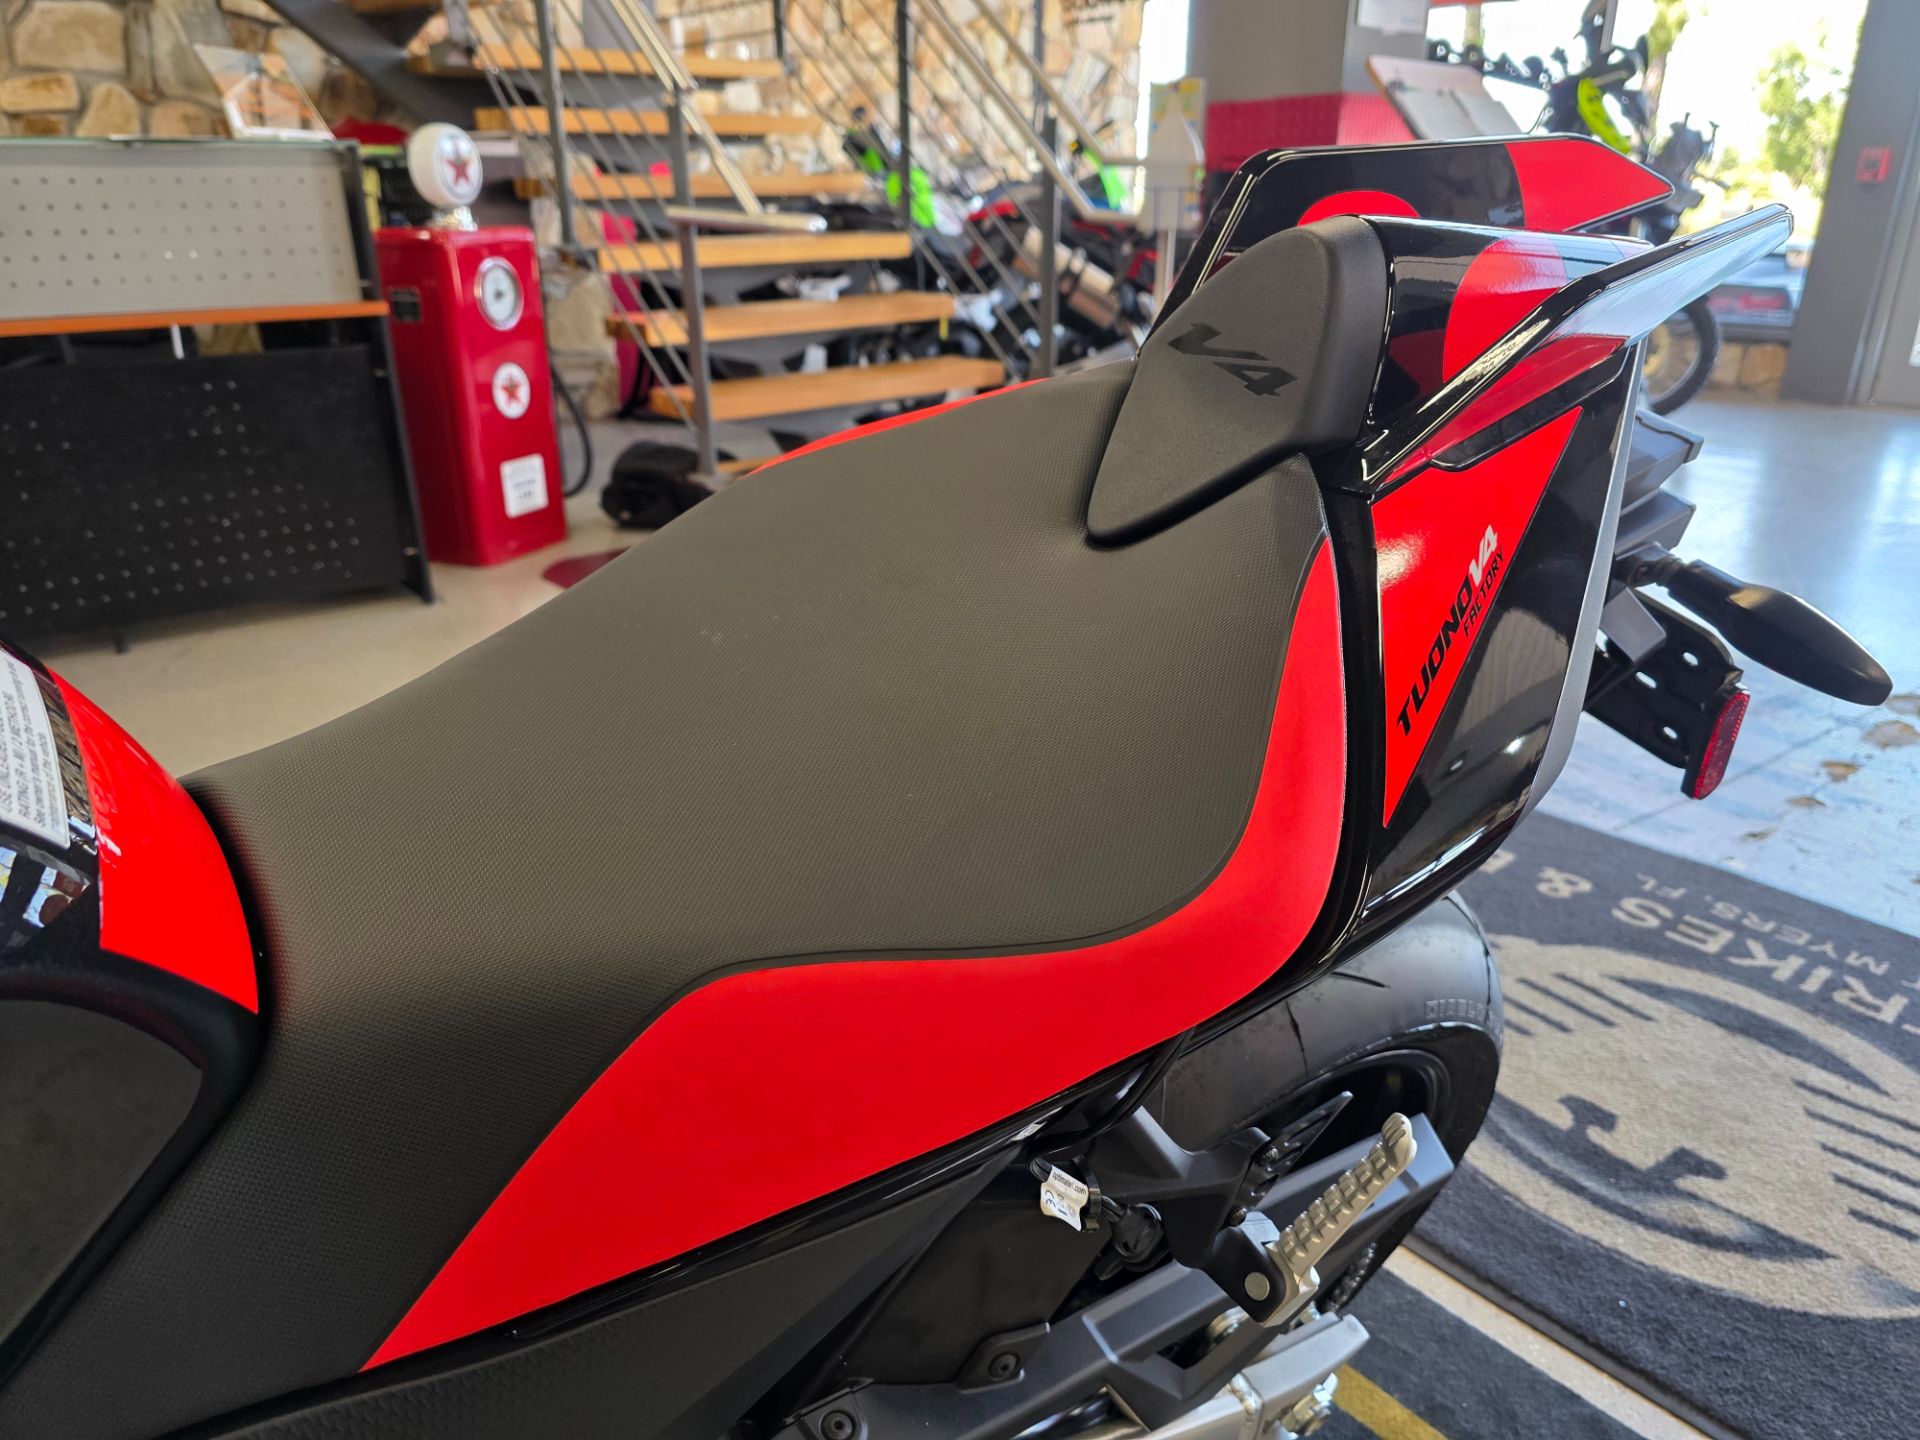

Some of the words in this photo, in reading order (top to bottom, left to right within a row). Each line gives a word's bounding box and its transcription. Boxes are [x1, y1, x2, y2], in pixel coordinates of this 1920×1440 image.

[1167, 323, 1298, 397] V4
[1397, 575, 1474, 736] TUONO
[1469, 524, 1498, 587] V4
[1463, 546, 1504, 638] FACTORY
[1535, 866, 1594, 899] &
